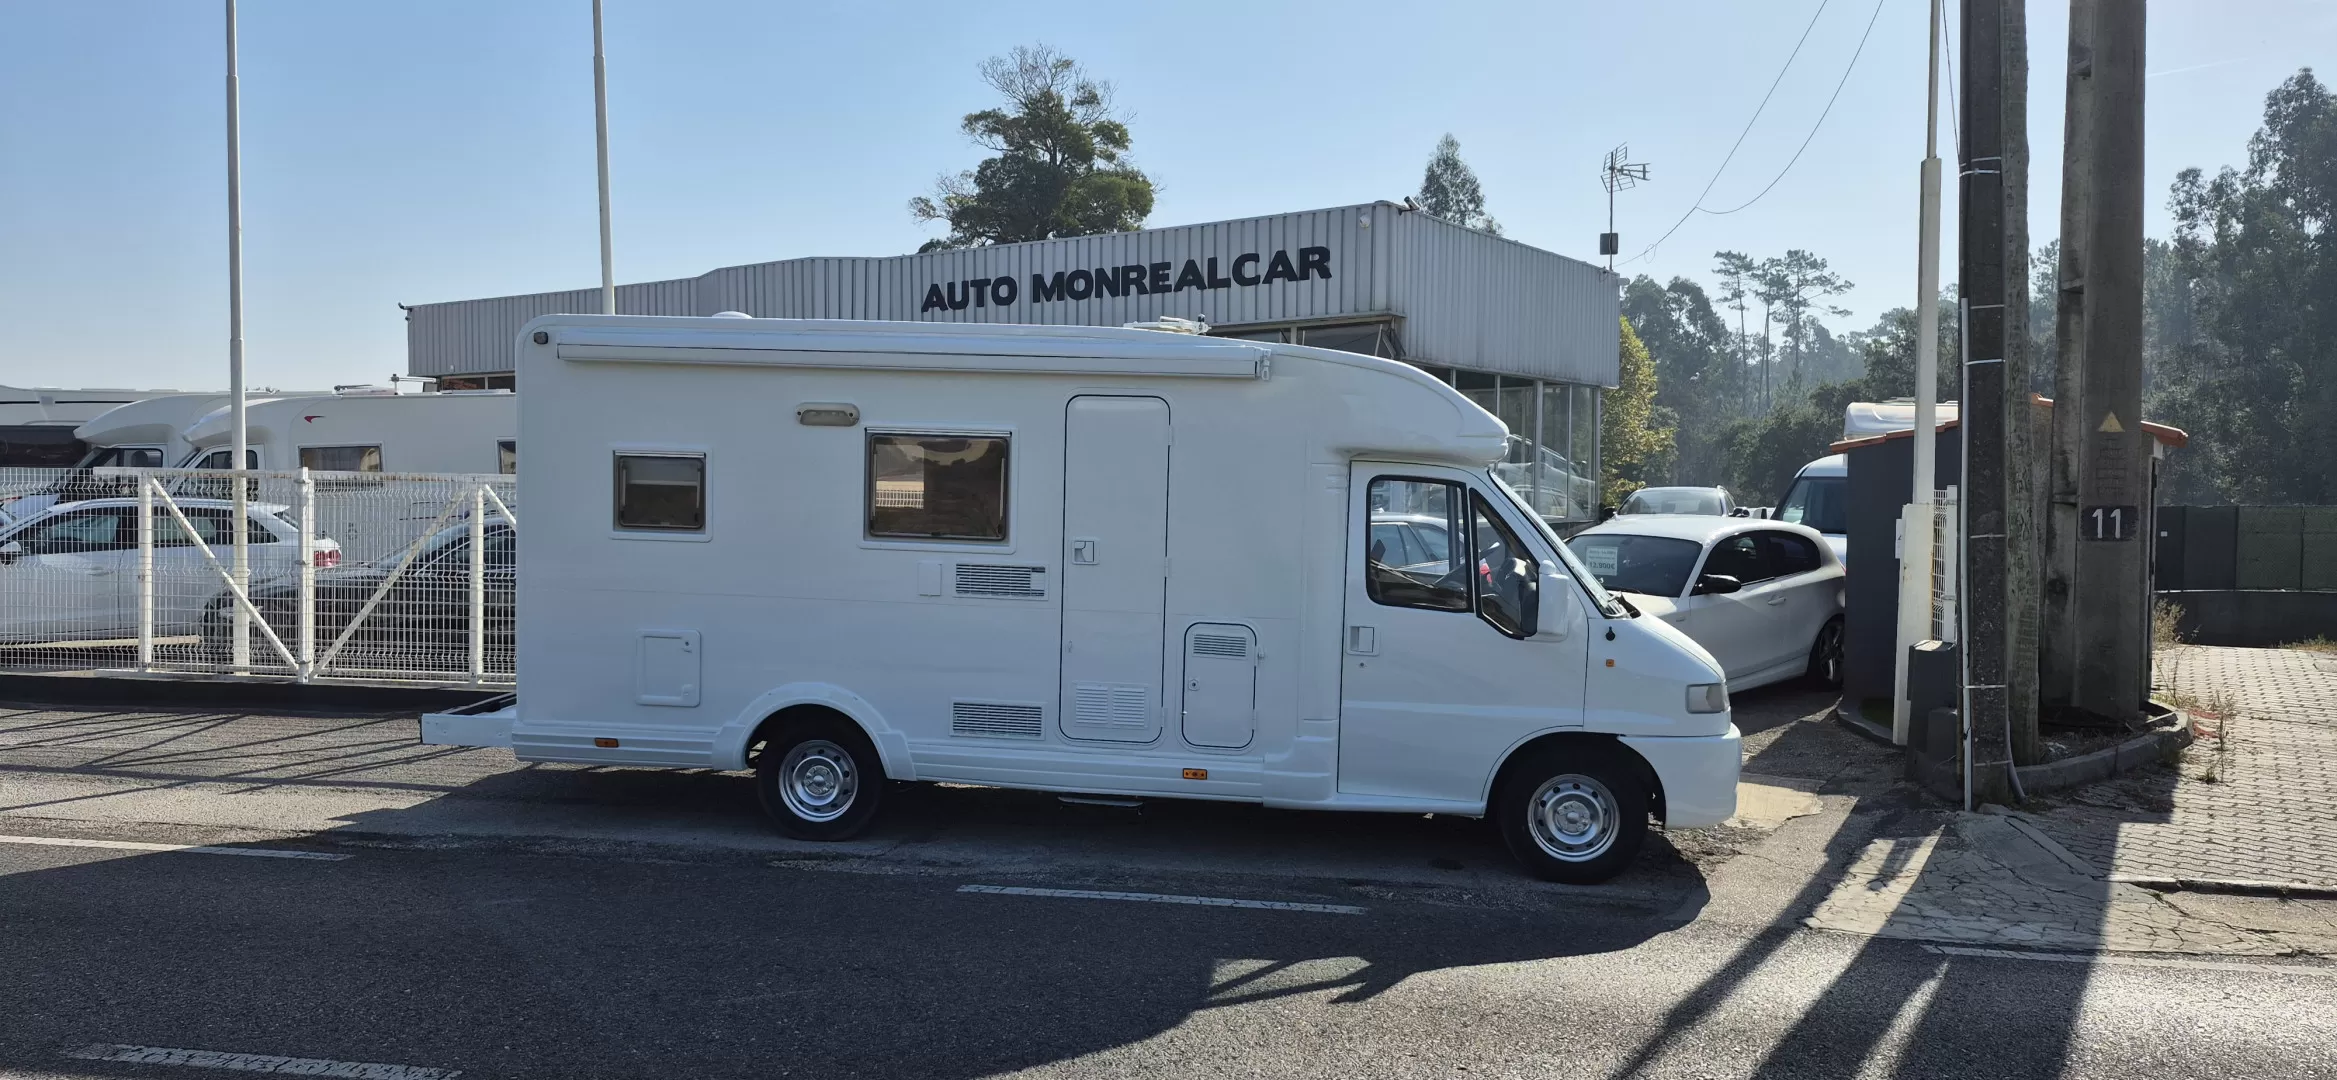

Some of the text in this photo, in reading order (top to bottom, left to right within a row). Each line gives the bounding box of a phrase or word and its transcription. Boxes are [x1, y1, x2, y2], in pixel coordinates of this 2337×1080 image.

[921, 247, 1333, 313] AUTO MONREALCAR
[2092, 508, 2121, 539] 11
